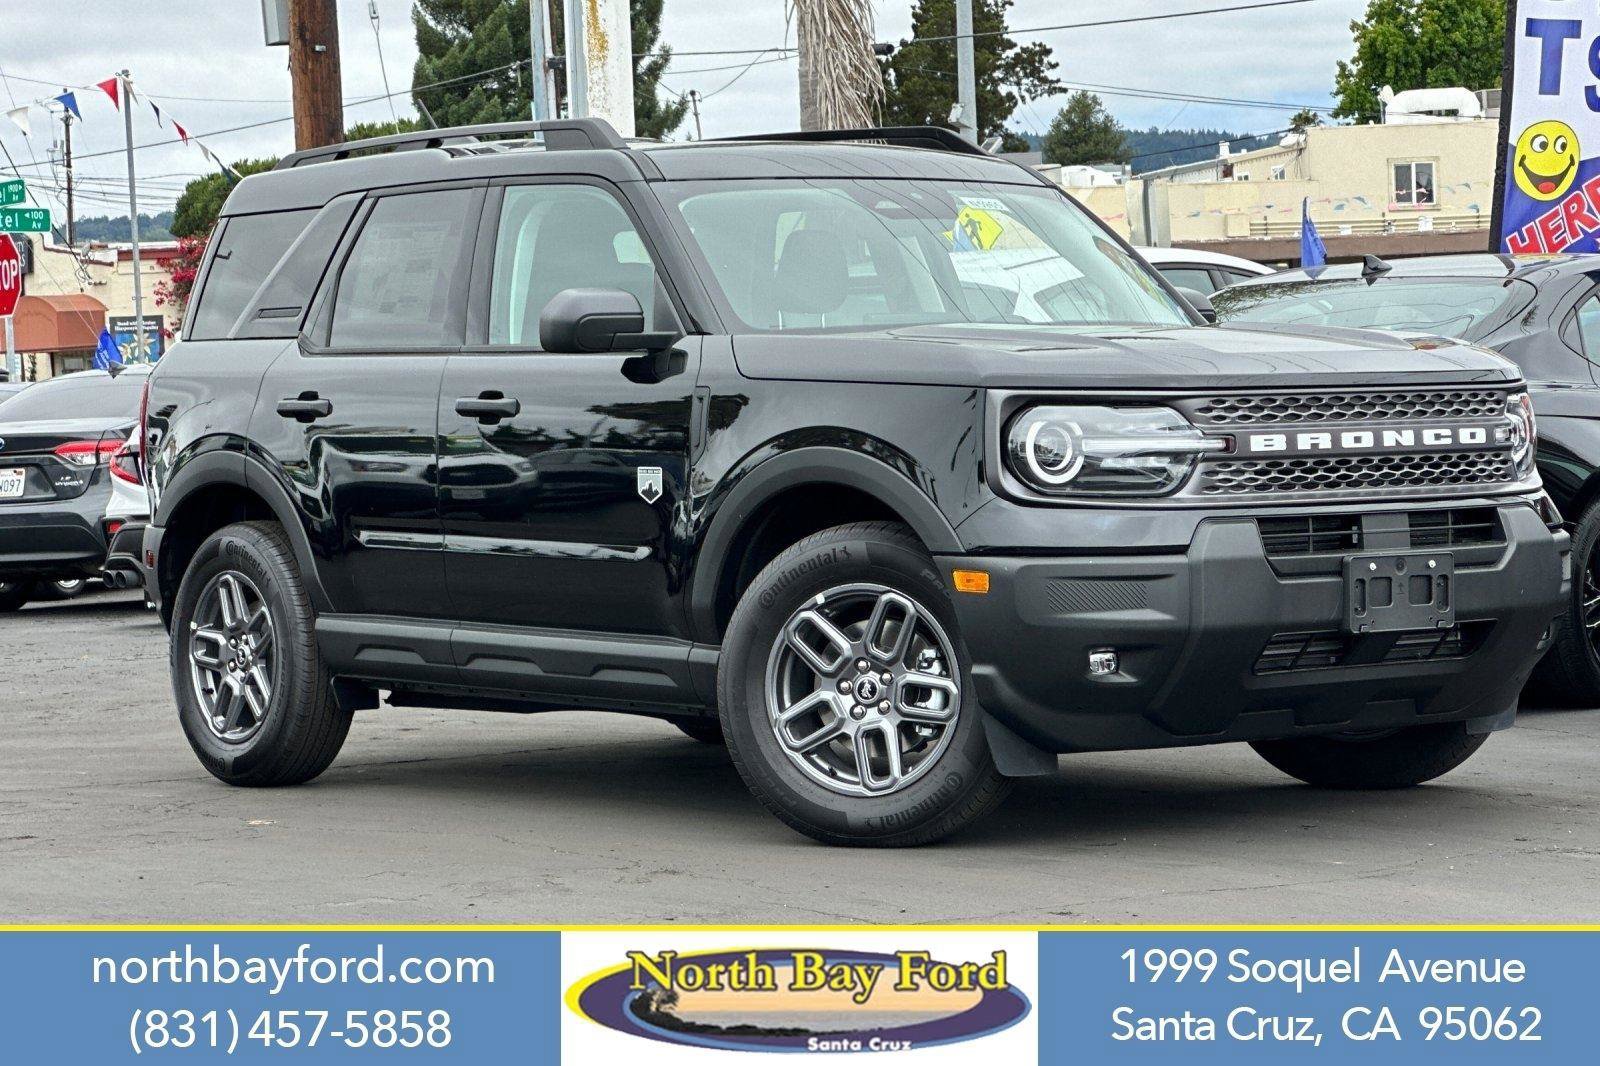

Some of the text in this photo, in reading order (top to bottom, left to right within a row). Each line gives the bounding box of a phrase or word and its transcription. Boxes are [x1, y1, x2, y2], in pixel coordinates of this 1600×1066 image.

[31, 211, 44, 220] 100
[32, 220, 42, 229] Av
[1250, 428, 1486, 451] BRONCO
[760, 547, 838, 609] Continental
